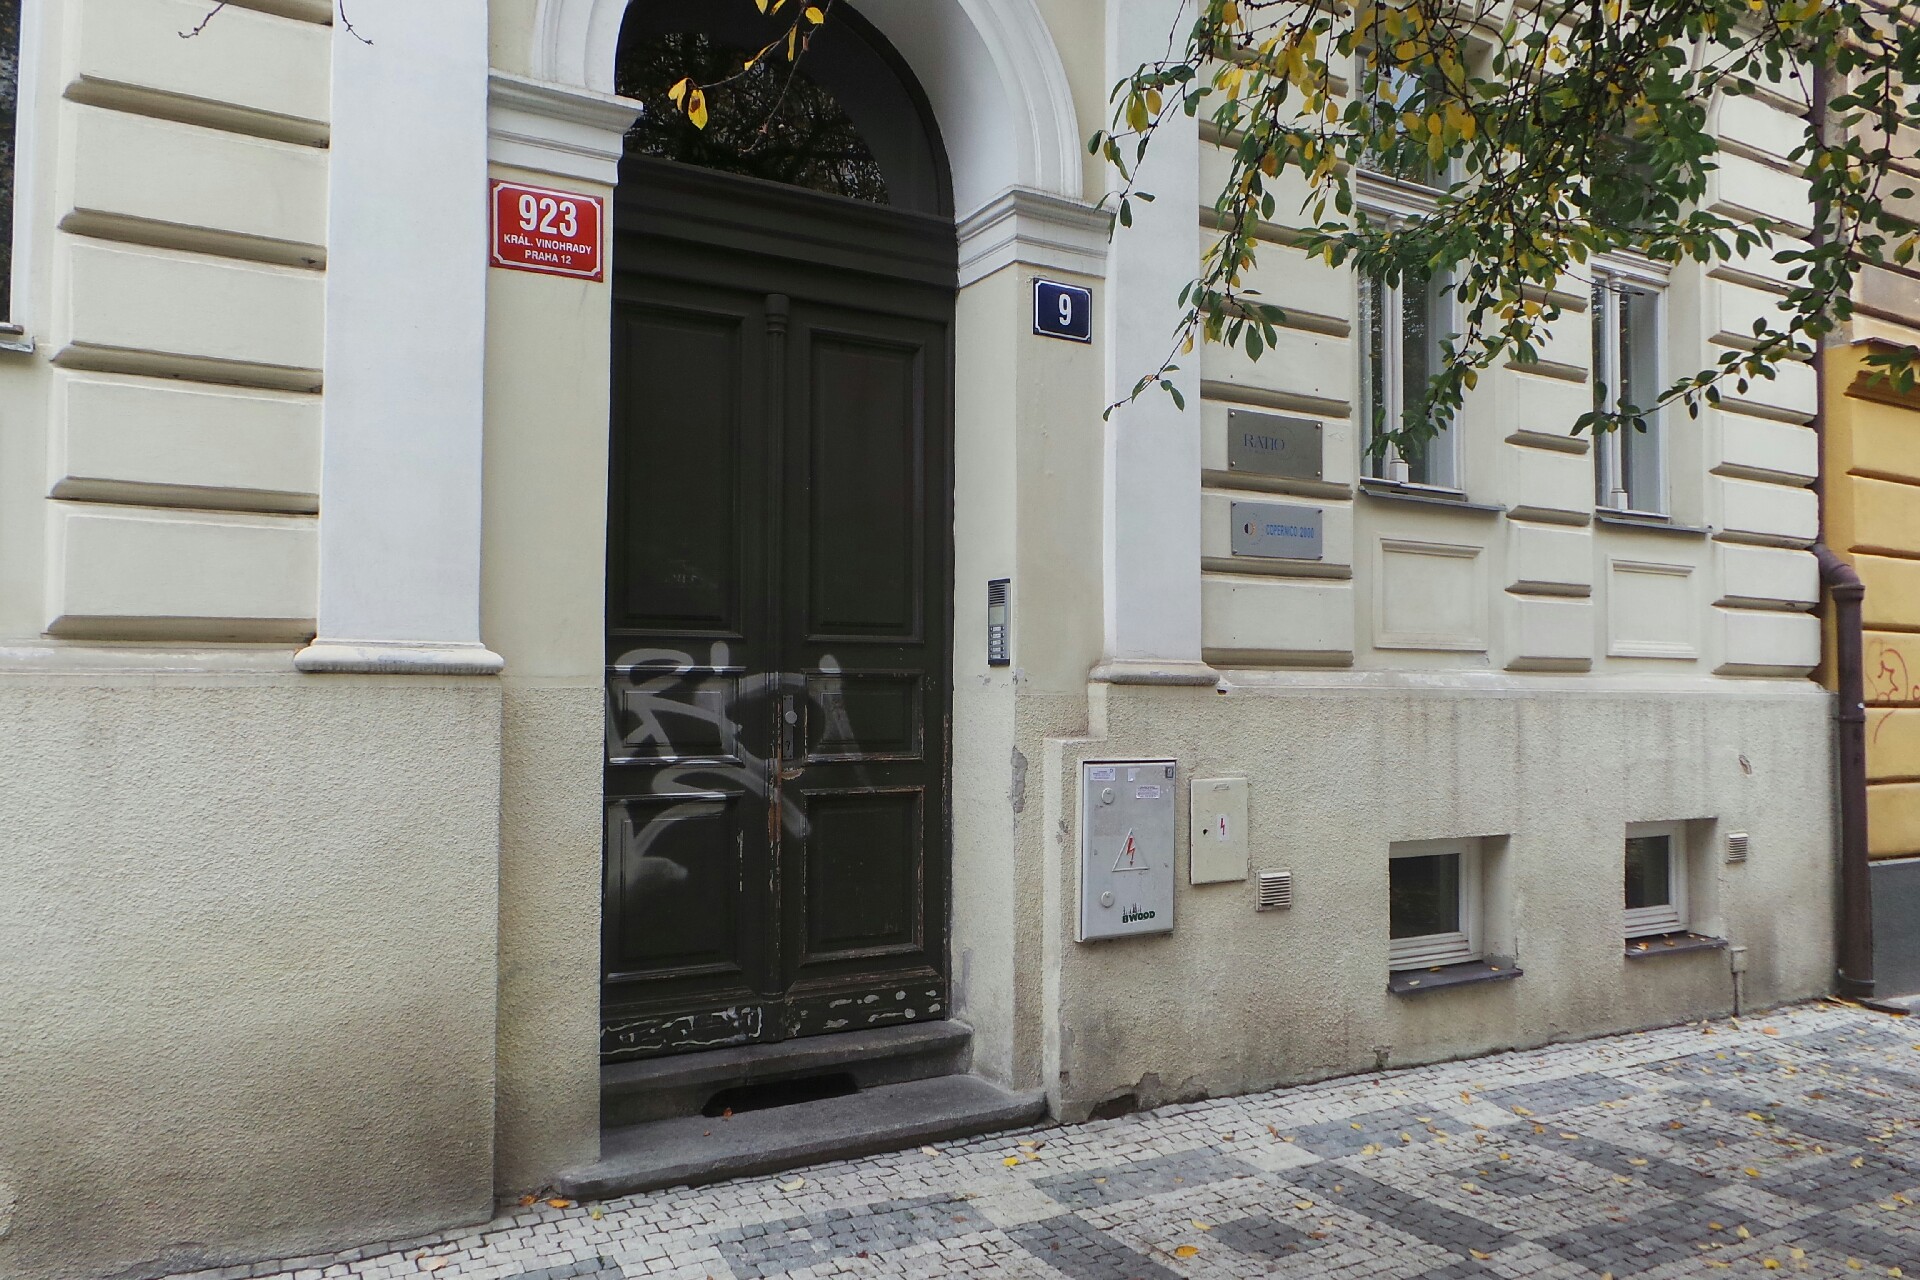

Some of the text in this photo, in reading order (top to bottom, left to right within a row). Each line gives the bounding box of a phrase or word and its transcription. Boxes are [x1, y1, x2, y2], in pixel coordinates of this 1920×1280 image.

[518, 194, 578, 237] 923
[503, 232, 592, 255] KRÁL. VINOHRADY
[524, 249, 572, 265] PRAHA 12
[1058, 293, 1072, 326] 9
[1244, 433, 1285, 451] RATIO
[1299, 526, 1315, 539] 2000
